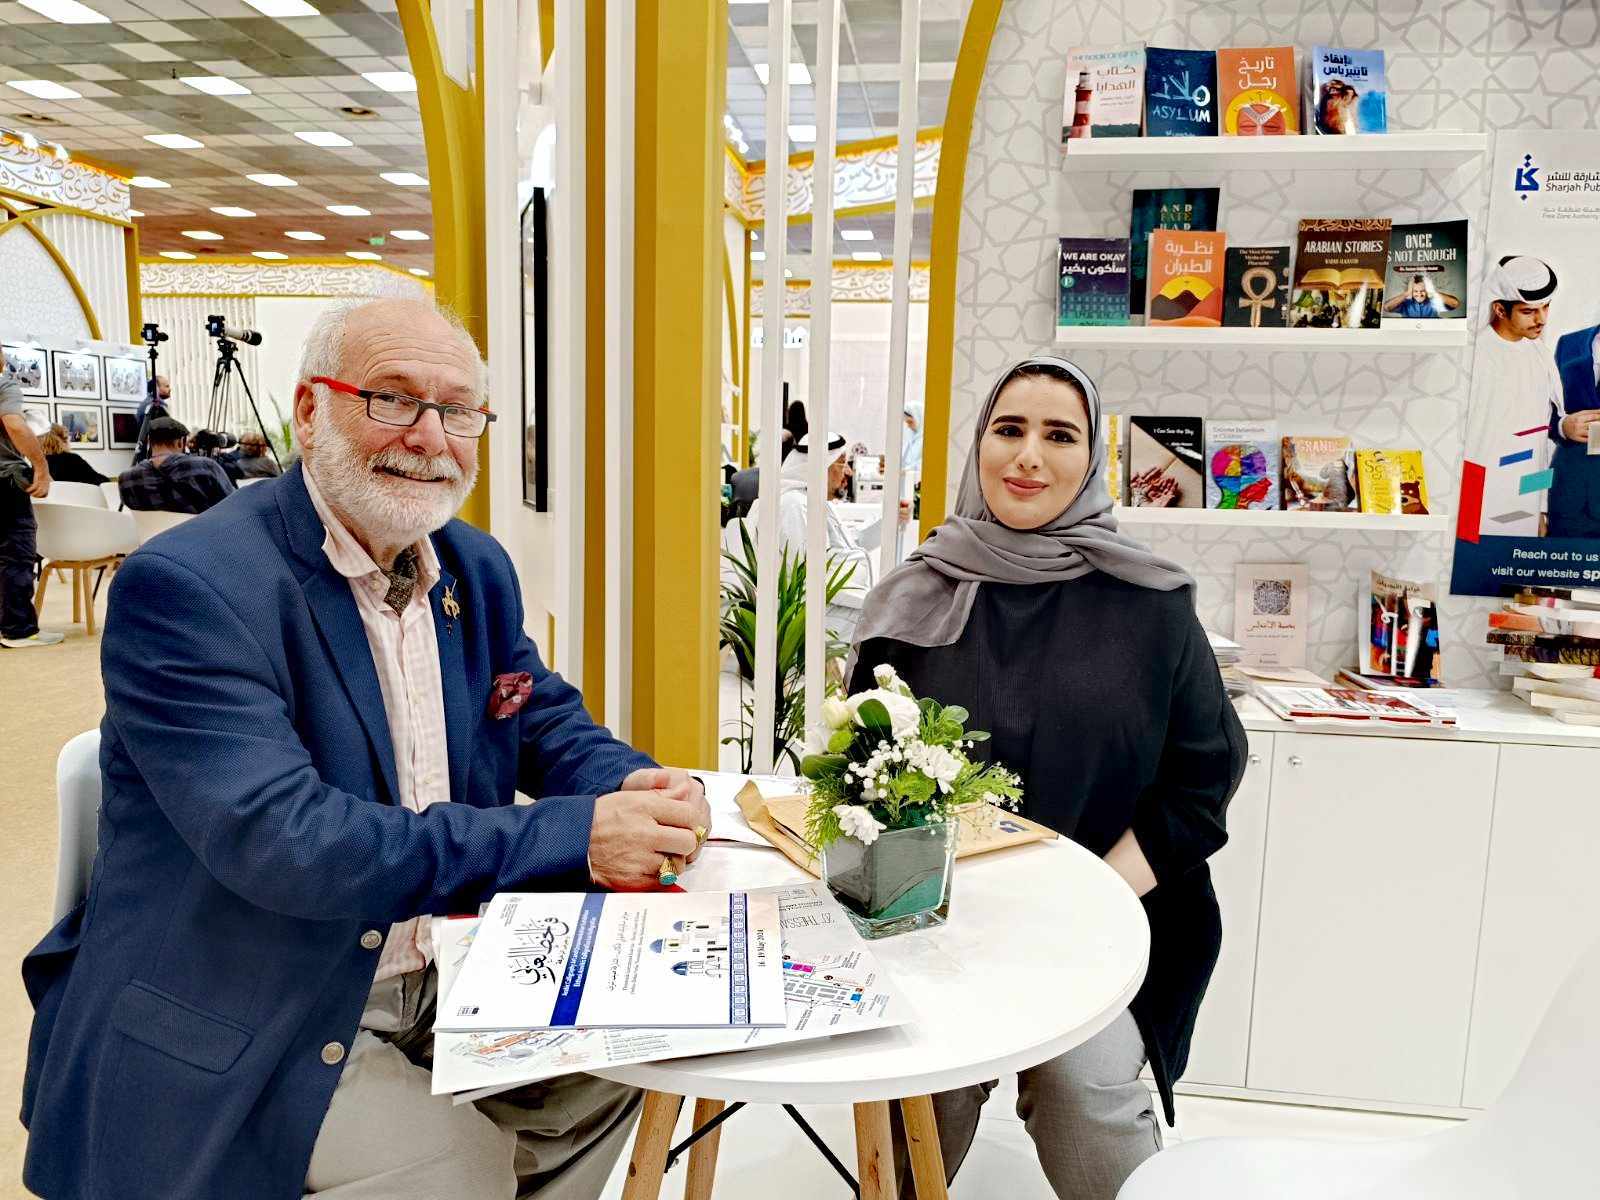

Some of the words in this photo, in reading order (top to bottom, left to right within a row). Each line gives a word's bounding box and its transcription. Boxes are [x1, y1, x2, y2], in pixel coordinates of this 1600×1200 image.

[1238, 56, 1275, 75] تاريخ
[1238, 73, 1277, 90] رجل
[1152, 105, 1211, 123] ASYLUM
[1545, 182, 1581, 193] Sharjah
[1161, 203, 1193, 213] AND
[1165, 240, 1214, 256] نظرية
[1304, 240, 1343, 254] ARABIAN
[1345, 239, 1384, 254] STORIES
[1405, 233, 1433, 249] ONCE
[1063, 252, 1078, 261] WE
[1079, 252, 1098, 261] ARE
[1100, 252, 1126, 261] OKAY
[1394, 250, 1414, 263] NOT
[1417, 248, 1457, 263] ENOUGH
[1062, 264, 1086, 275] بخير
[1087, 261, 1127, 275] سأكون
[1165, 259, 1212, 275] الطيران
[1512, 548, 1547, 560] Reach
[1550, 551, 1569, 561] out
[1571, 551, 1582, 561] to
[1585, 553, 1599, 562] us
[1491, 566, 1514, 576] visit
[1516, 568, 1535, 577] our
[1537, 567, 1580, 579] website
